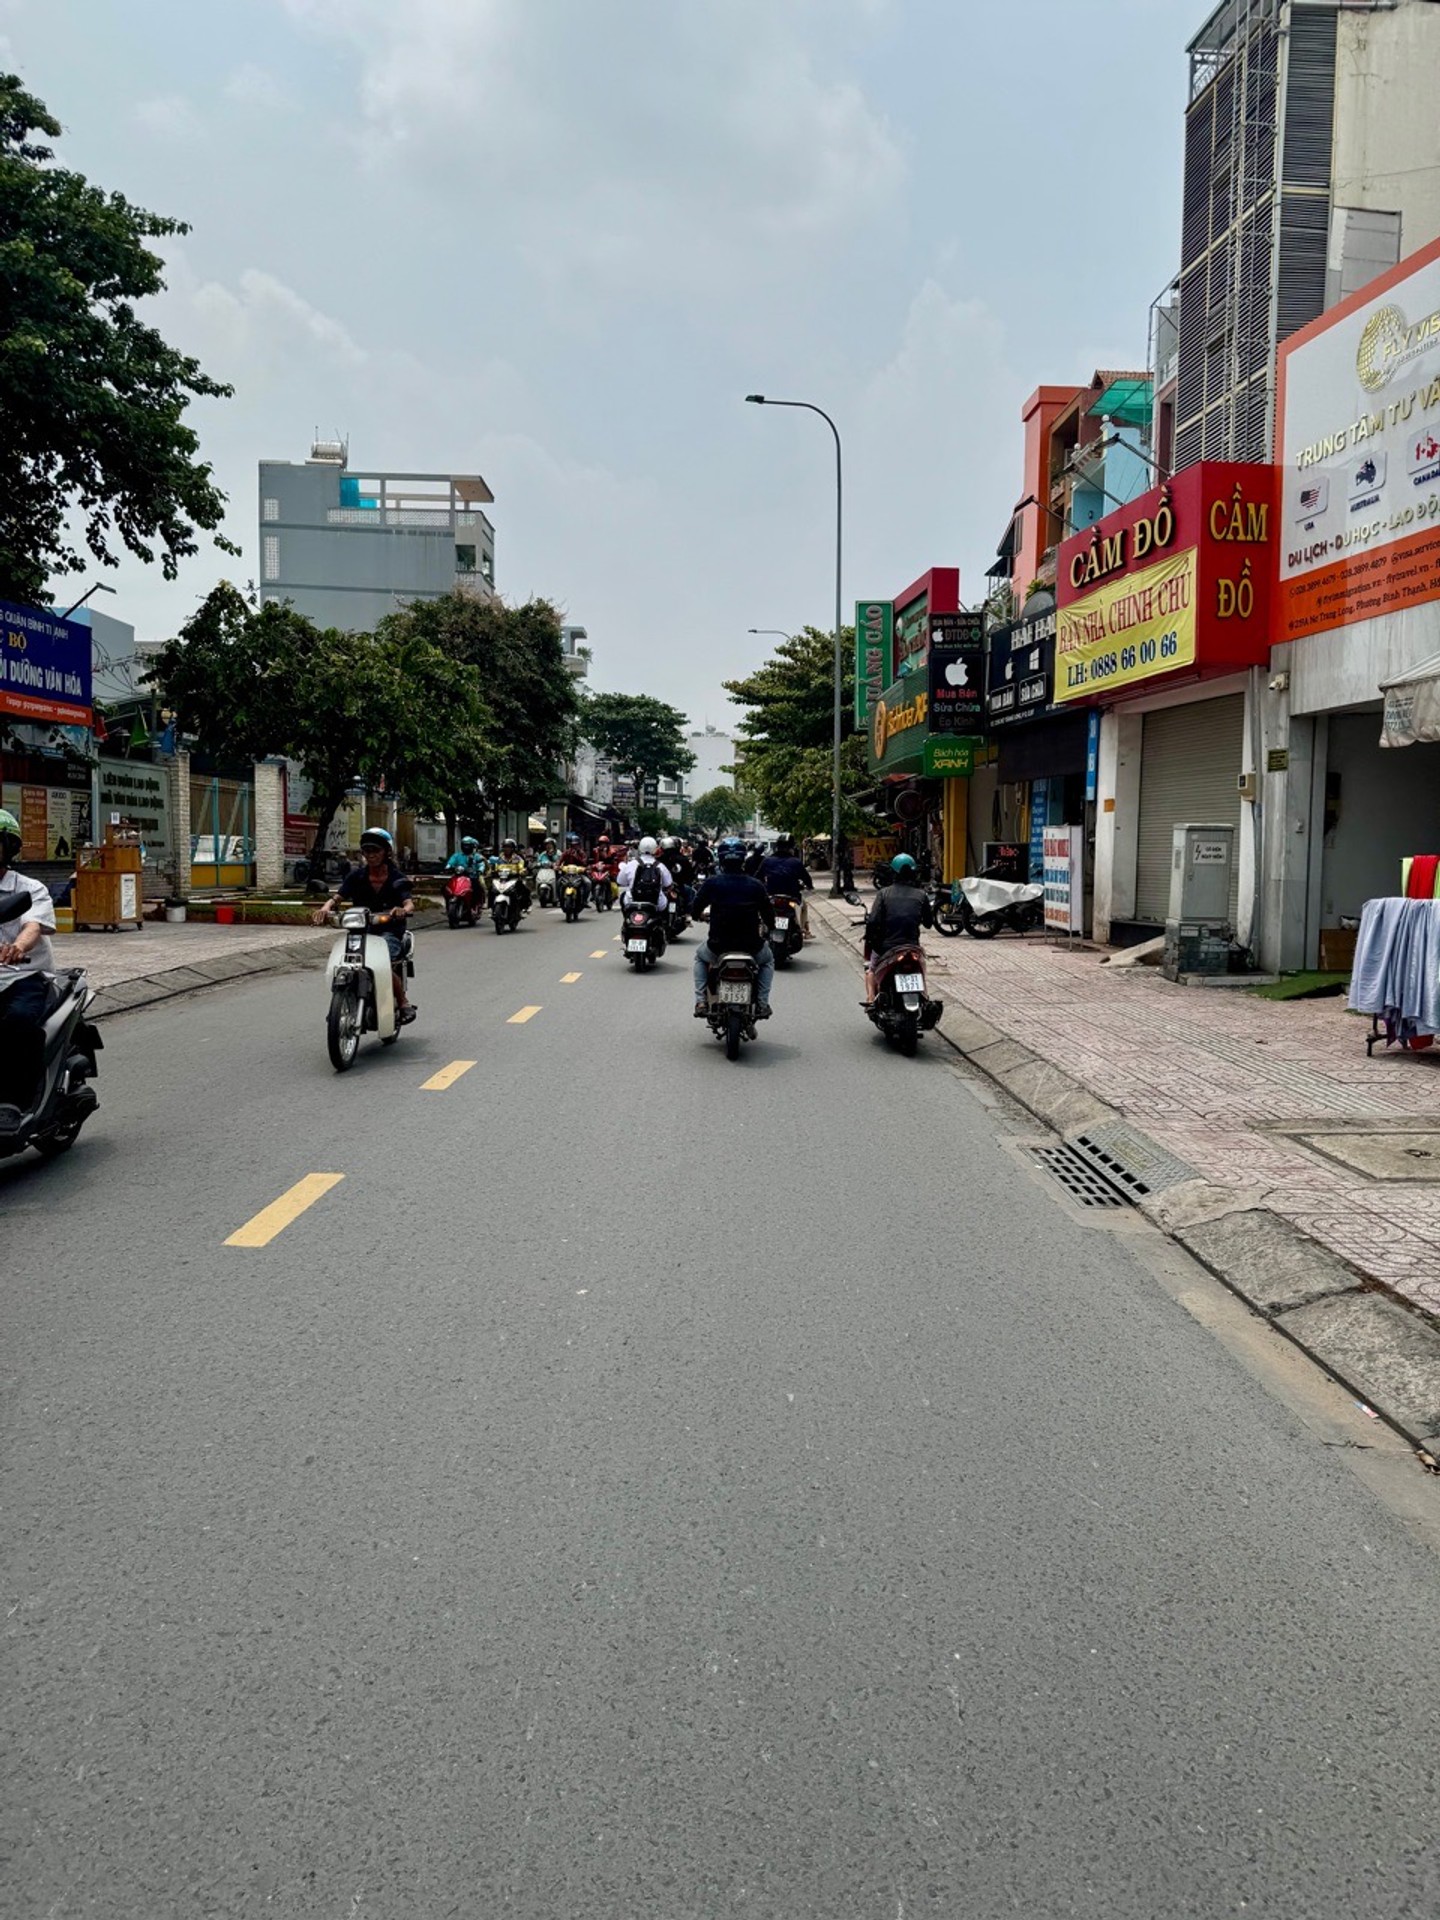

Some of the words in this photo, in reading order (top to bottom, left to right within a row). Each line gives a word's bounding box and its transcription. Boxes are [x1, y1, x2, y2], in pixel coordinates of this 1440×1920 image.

[1383, 328, 1413, 362] FLY
[1296, 431, 1347, 472] TRUNG
[1350, 408, 1386, 446] TÂM
[1389, 390, 1417, 426] TƯ
[1210, 482, 1269, 542] CẦM
[1070, 526, 1124, 590] CẦM
[1133, 485, 1173, 560] ĐỒ
[1288, 549, 1302, 568] DU
[1304, 539, 1328, 564] LỊCH
[1352, 521, 1380, 545] HỌC
[1389, 505, 1415, 531] LAO
[1109, 585, 1153, 635] CHÍNH
[1217, 558, 1254, 619] ĐỒ
[8, 631, 27, 653] BỘ
[860, 605, 883, 645] CÁO
[1067, 660, 1089, 688] LH:
[1090, 651, 1118, 681] 0888
[1120, 644, 1136, 671] 66
[1139, 638, 1156, 662] 00
[1160, 631, 1178, 657] 66
[933, 702, 953, 713] Sửa
[955, 702, 981, 713] Chữa
[936, 689, 956, 698] Mua
[959, 687, 978, 699] Bán
[932, 759, 969, 770] XANH
[933, 747, 953, 758] Bách
[954, 747, 969, 758] hóa
